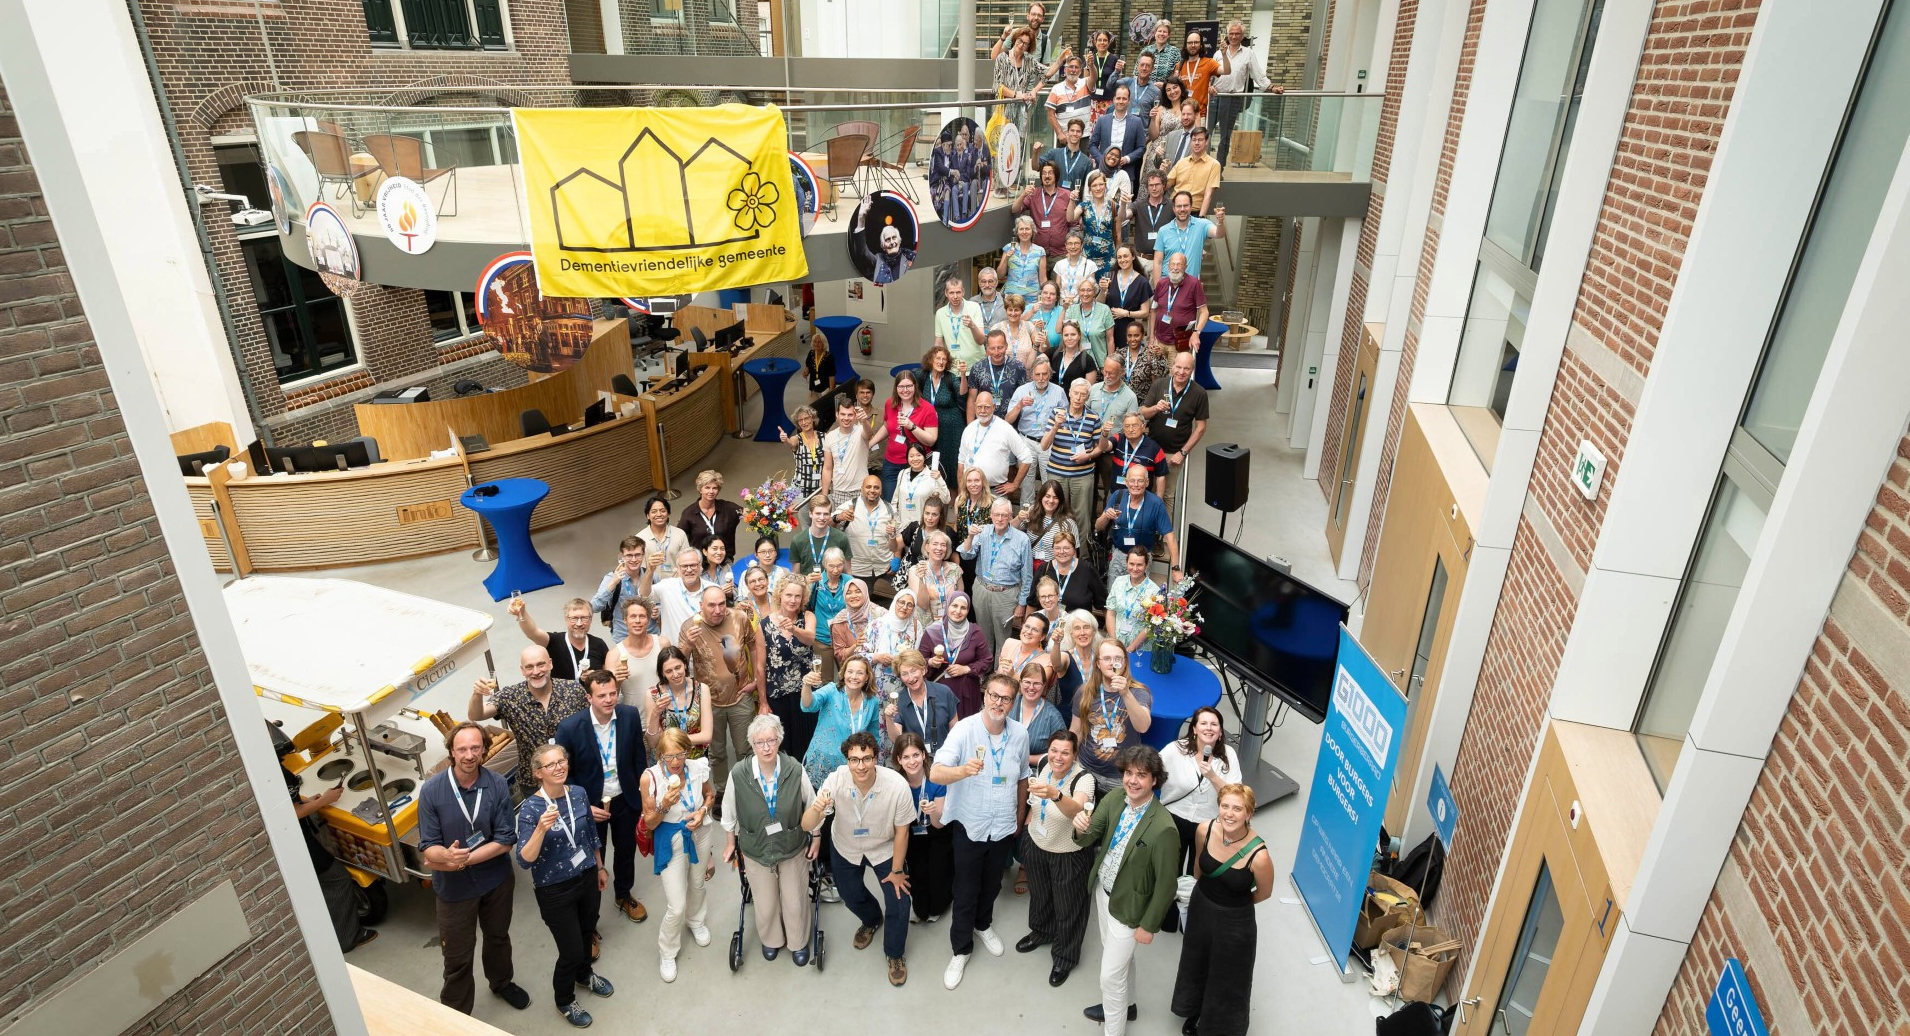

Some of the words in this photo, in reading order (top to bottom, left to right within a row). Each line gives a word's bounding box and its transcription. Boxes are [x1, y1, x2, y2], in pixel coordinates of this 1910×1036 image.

[561, 256, 714, 273] Dementievriendelijke
[719, 244, 787, 268] gemeente
[402, 504, 448, 523] info
[1336, 672, 1389, 753] G1000
[1325, 731, 1345, 763] DOOR
[1344, 759, 1373, 807] BURGERS
[1337, 766, 1355, 800] VOOR
[1327, 773, 1358, 825] BURGERS!
[1726, 987, 1748, 1036] Gee
